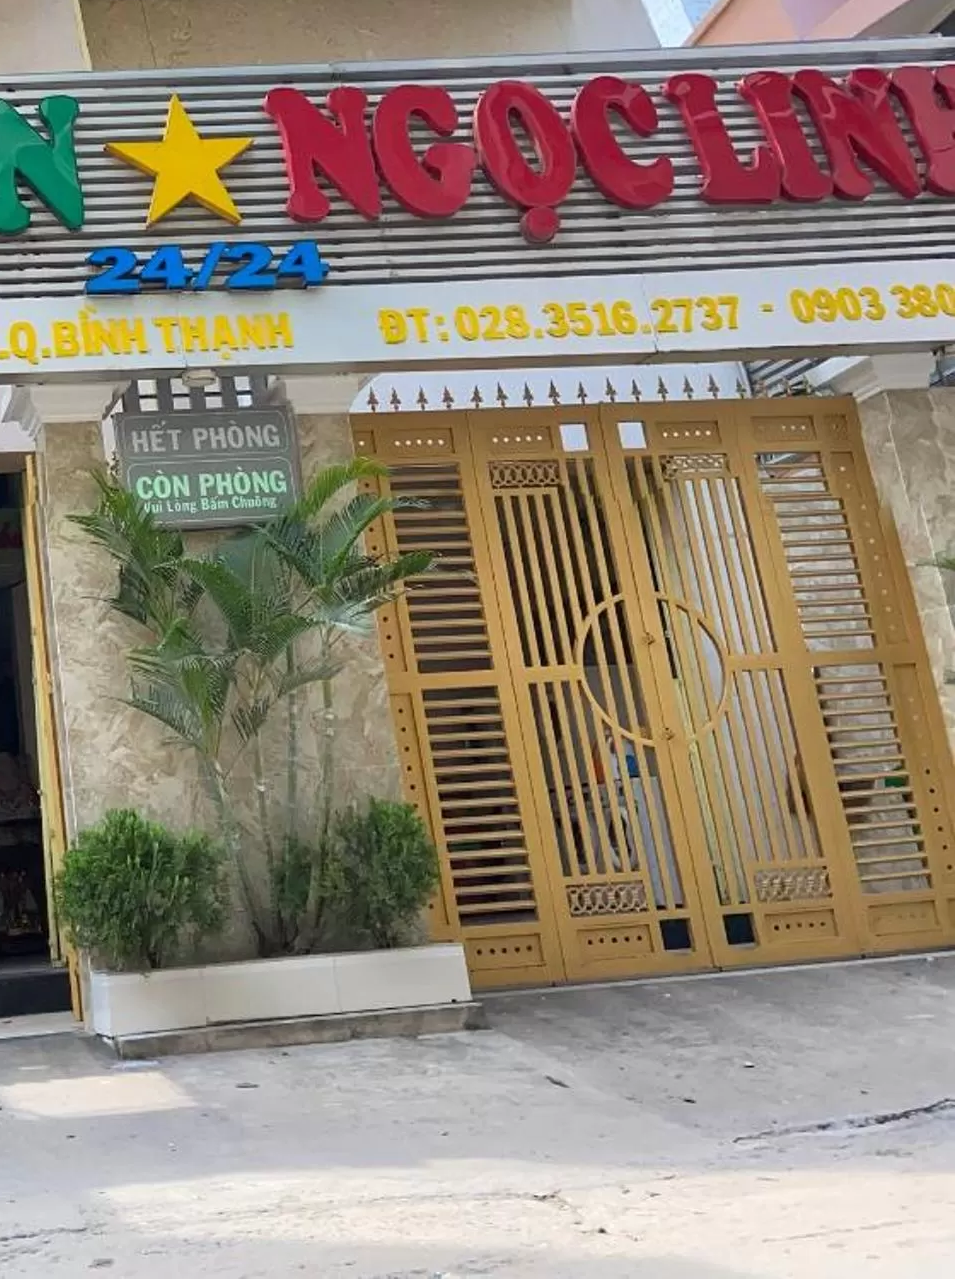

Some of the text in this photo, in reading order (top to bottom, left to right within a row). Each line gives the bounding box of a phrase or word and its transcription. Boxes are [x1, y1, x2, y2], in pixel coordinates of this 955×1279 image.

[264, 75, 674, 244] NGỌC
[85, 239, 330, 295] 24/24
[790, 286, 886, 324] 0903
[891, 283, 955, 319] 380
[153, 312, 294, 360] THẠNH
[131, 420, 281, 453] HẾT PHÒNG
[135, 467, 287, 500] CÒN PHÒNG
[144, 499, 163, 513] Vui
[167, 499, 197, 514] Lòng
[201, 495, 229, 511] Bấm
